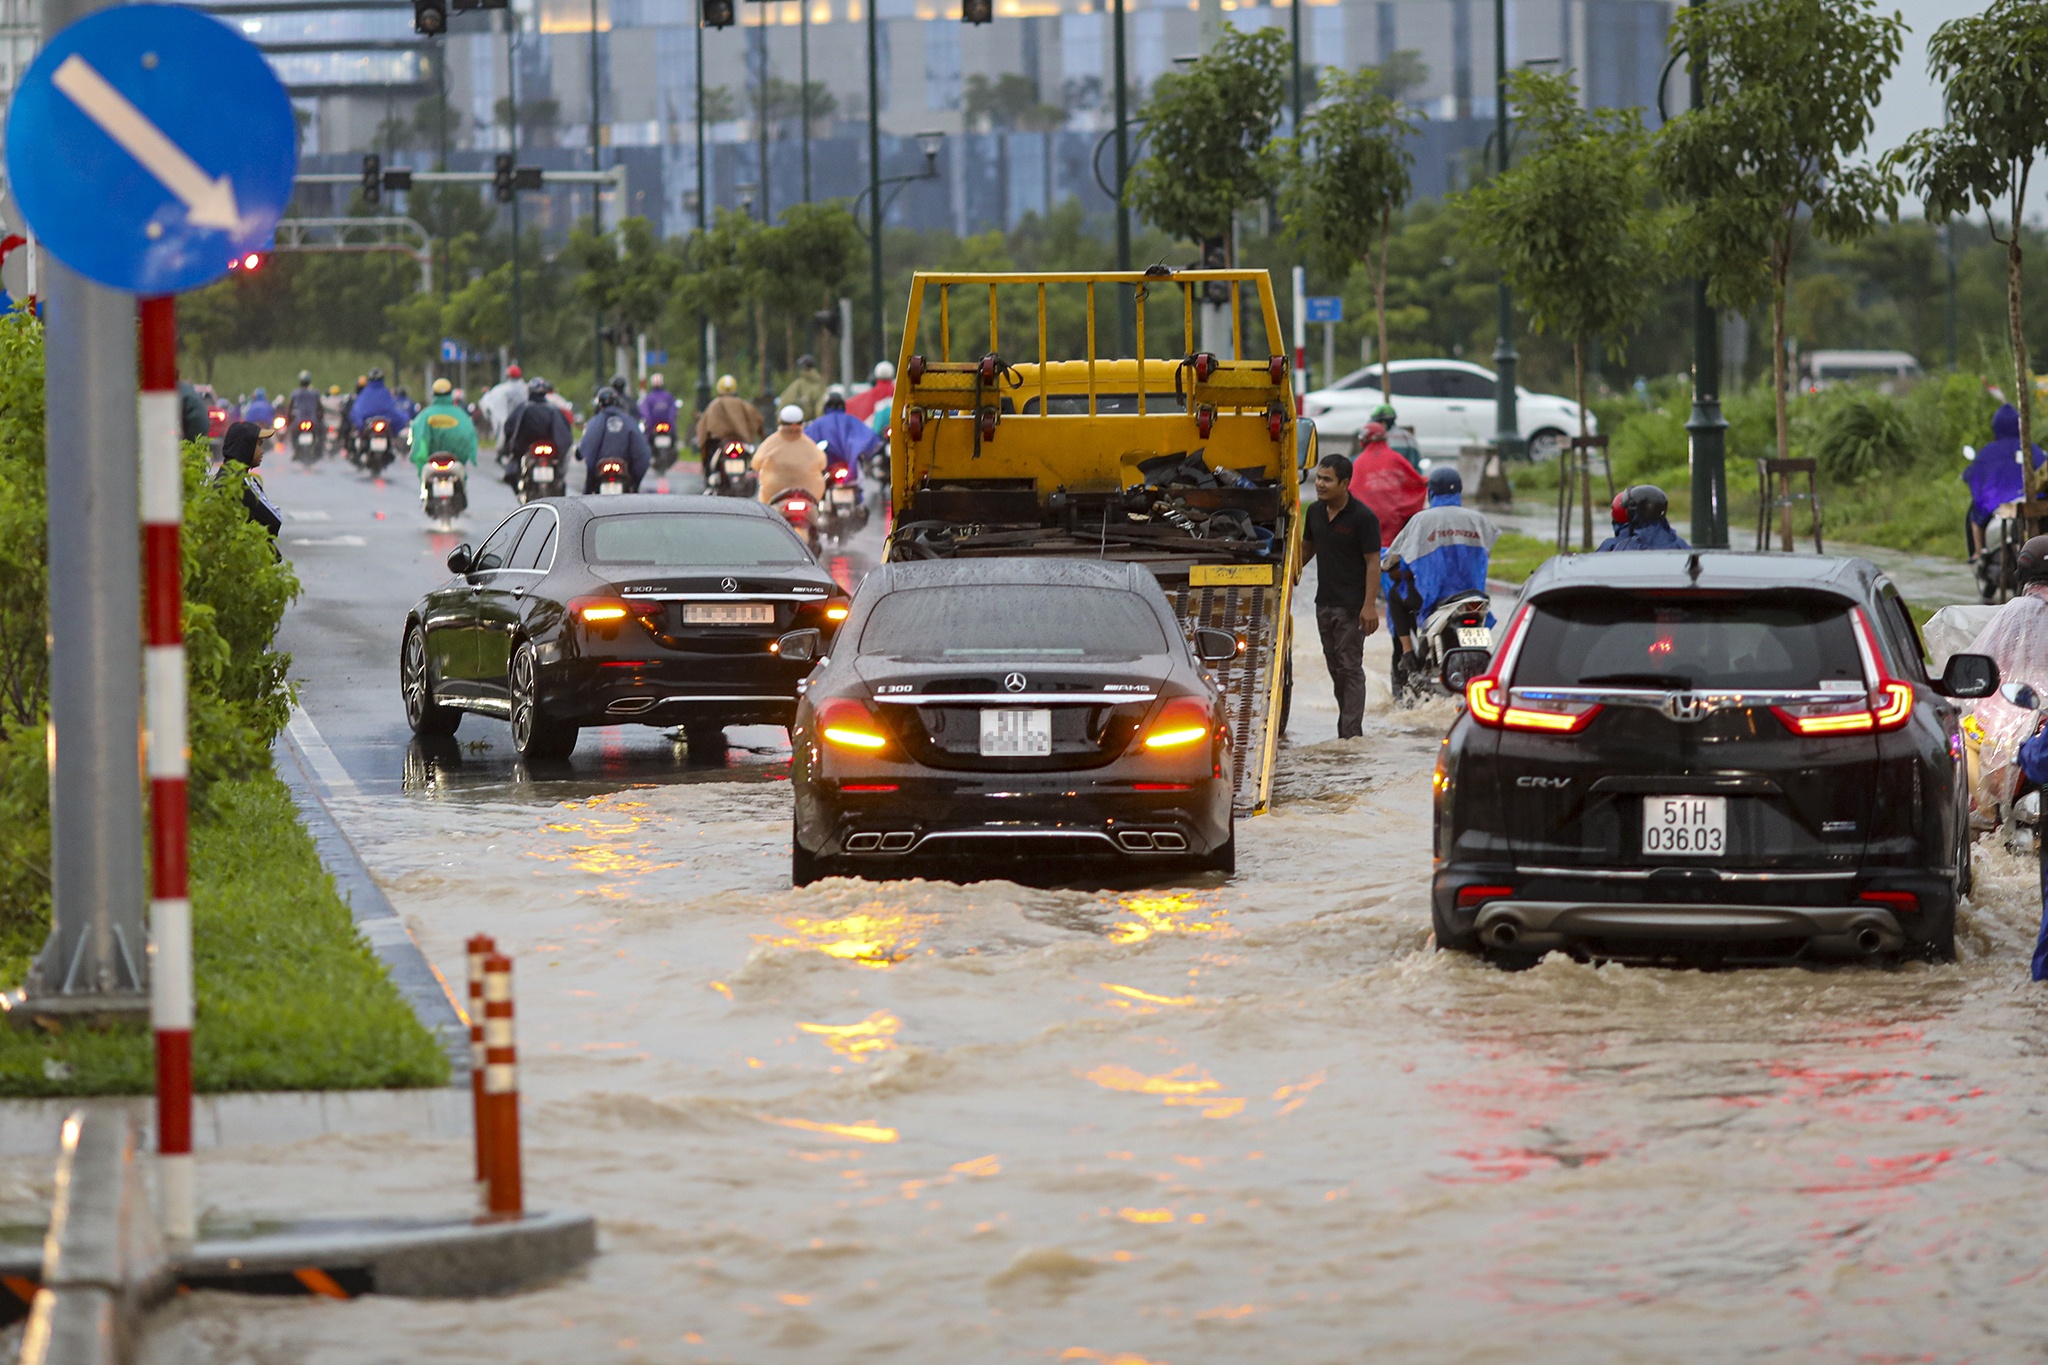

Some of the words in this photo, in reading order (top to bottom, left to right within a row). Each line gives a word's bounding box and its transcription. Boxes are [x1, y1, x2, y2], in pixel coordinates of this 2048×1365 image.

[1437, 528, 1481, 540] HONDA
[877, 685, 886, 693] E
[888, 684, 913, 693] 300
[1117, 684, 1150, 692] AMG
[1516, 776, 1571, 788] CR-V
[1663, 801, 1707, 825] 51H
[1647, 827, 1723, 852] 036.03
